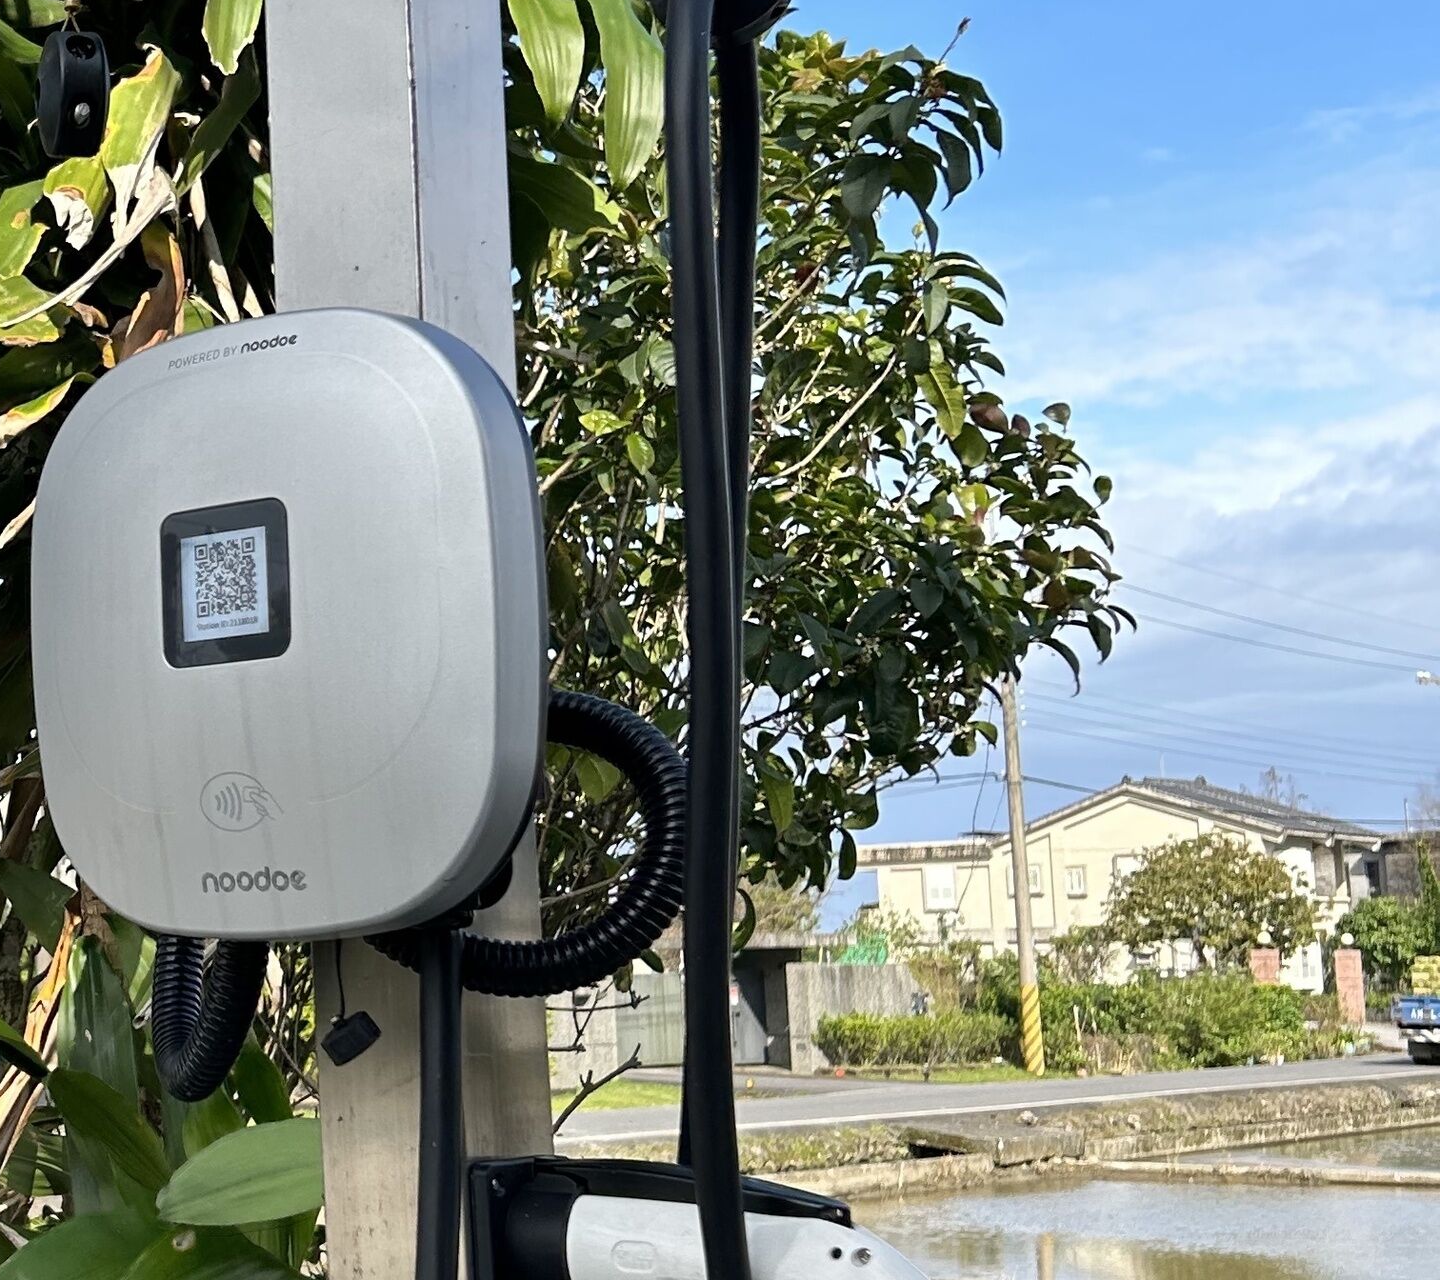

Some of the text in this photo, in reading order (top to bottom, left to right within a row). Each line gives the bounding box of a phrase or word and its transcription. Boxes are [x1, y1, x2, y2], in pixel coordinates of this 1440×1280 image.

[168, 334, 298, 370] POWERED BY noodoe
[201, 866, 308, 894] noodoe
